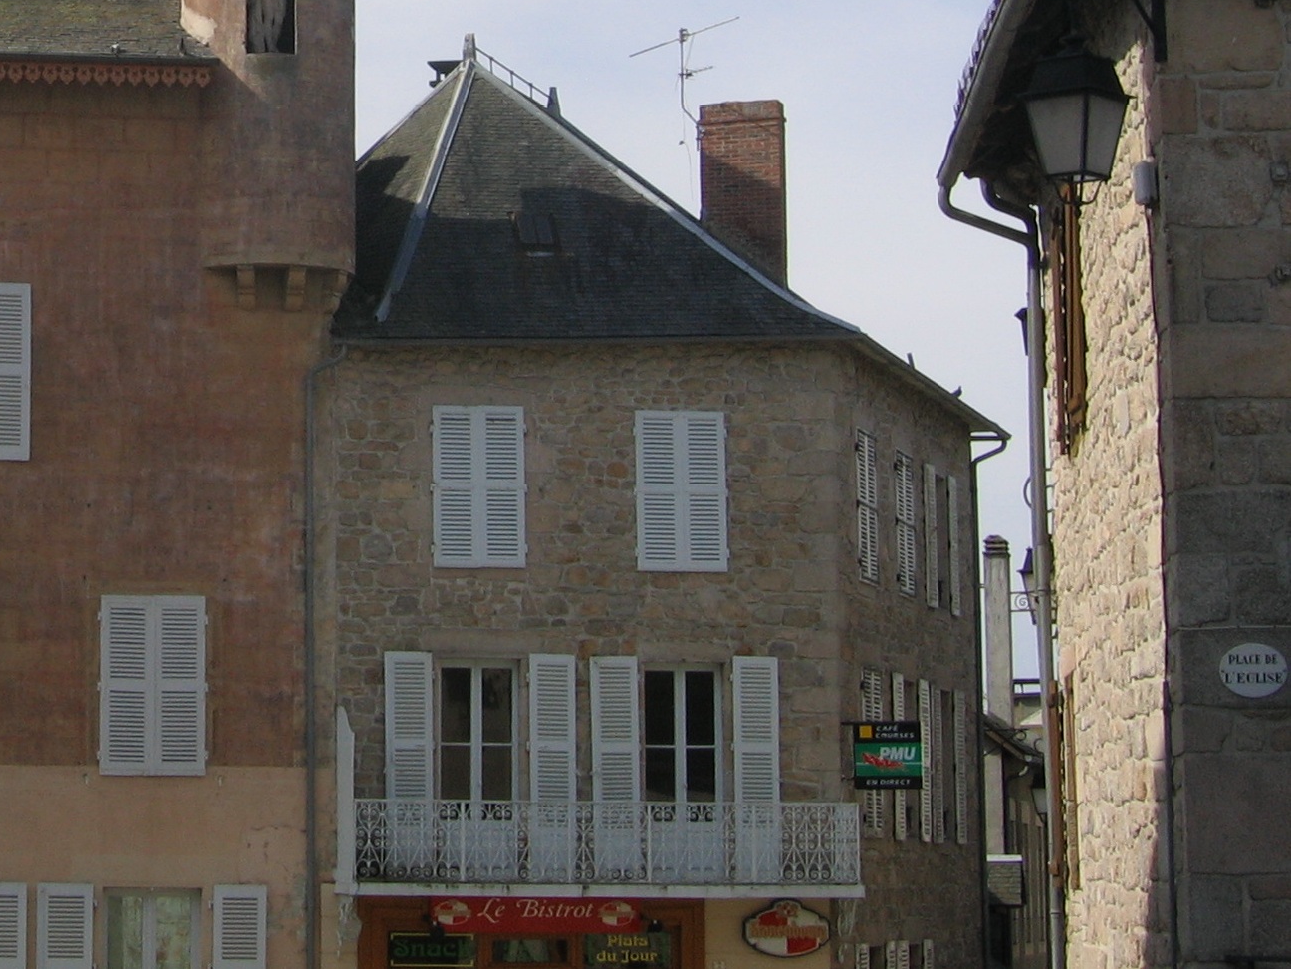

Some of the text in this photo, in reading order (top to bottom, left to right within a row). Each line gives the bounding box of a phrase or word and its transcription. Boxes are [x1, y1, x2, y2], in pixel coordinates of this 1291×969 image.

[1228, 654, 1278, 665] PLACE DE
[880, 747, 916, 760] PMU
[476, 897, 506, 924] Le
[516, 898, 594, 918] Bistrot
[607, 934, 648, 947] Plats
[596, 949, 658, 963] du Jour
